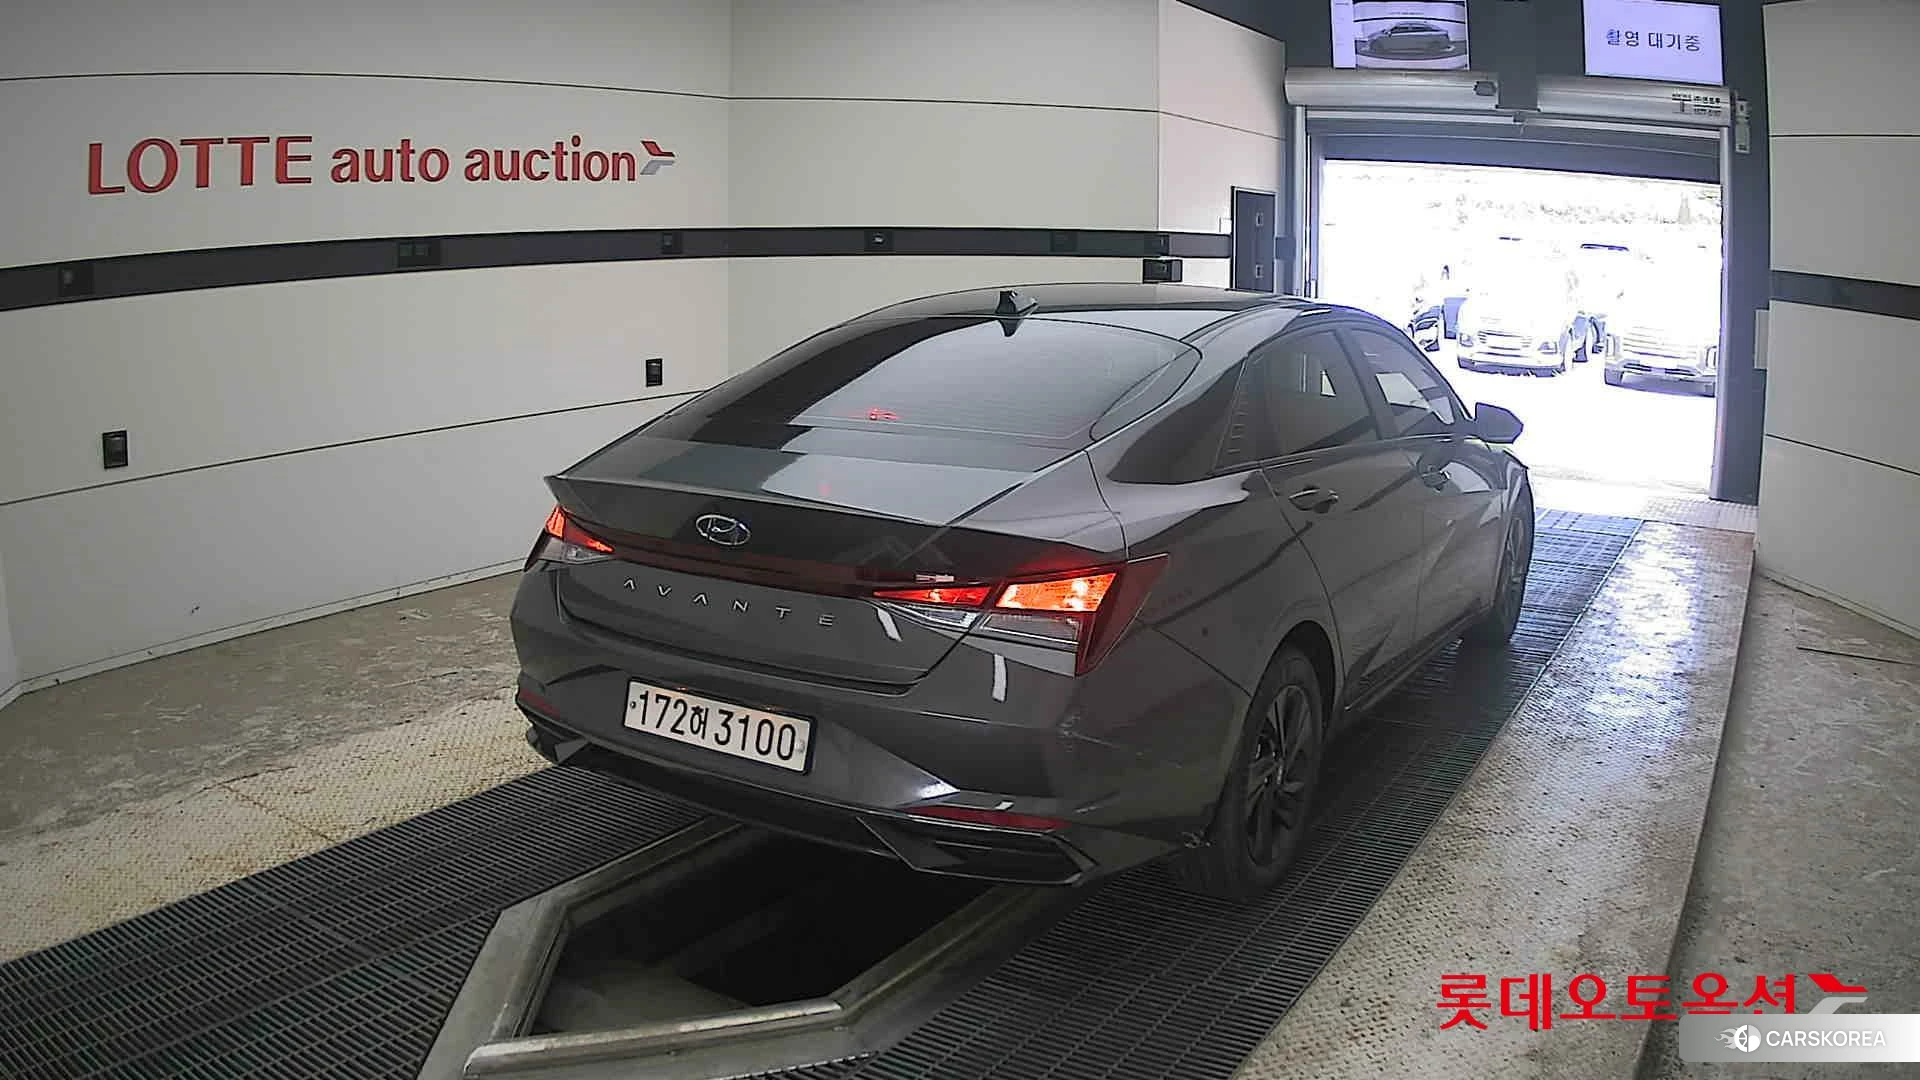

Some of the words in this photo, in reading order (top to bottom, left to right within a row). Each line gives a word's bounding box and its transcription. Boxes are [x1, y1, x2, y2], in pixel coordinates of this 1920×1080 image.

[1648, 32, 1700, 52] 대기중
[88, 136, 313, 195] LOTTE
[330, 138, 450, 183] auto
[464, 135, 636, 182] auction
[623, 577, 836, 626] AVANTE
[639, 690, 797, 761] 172허3100
